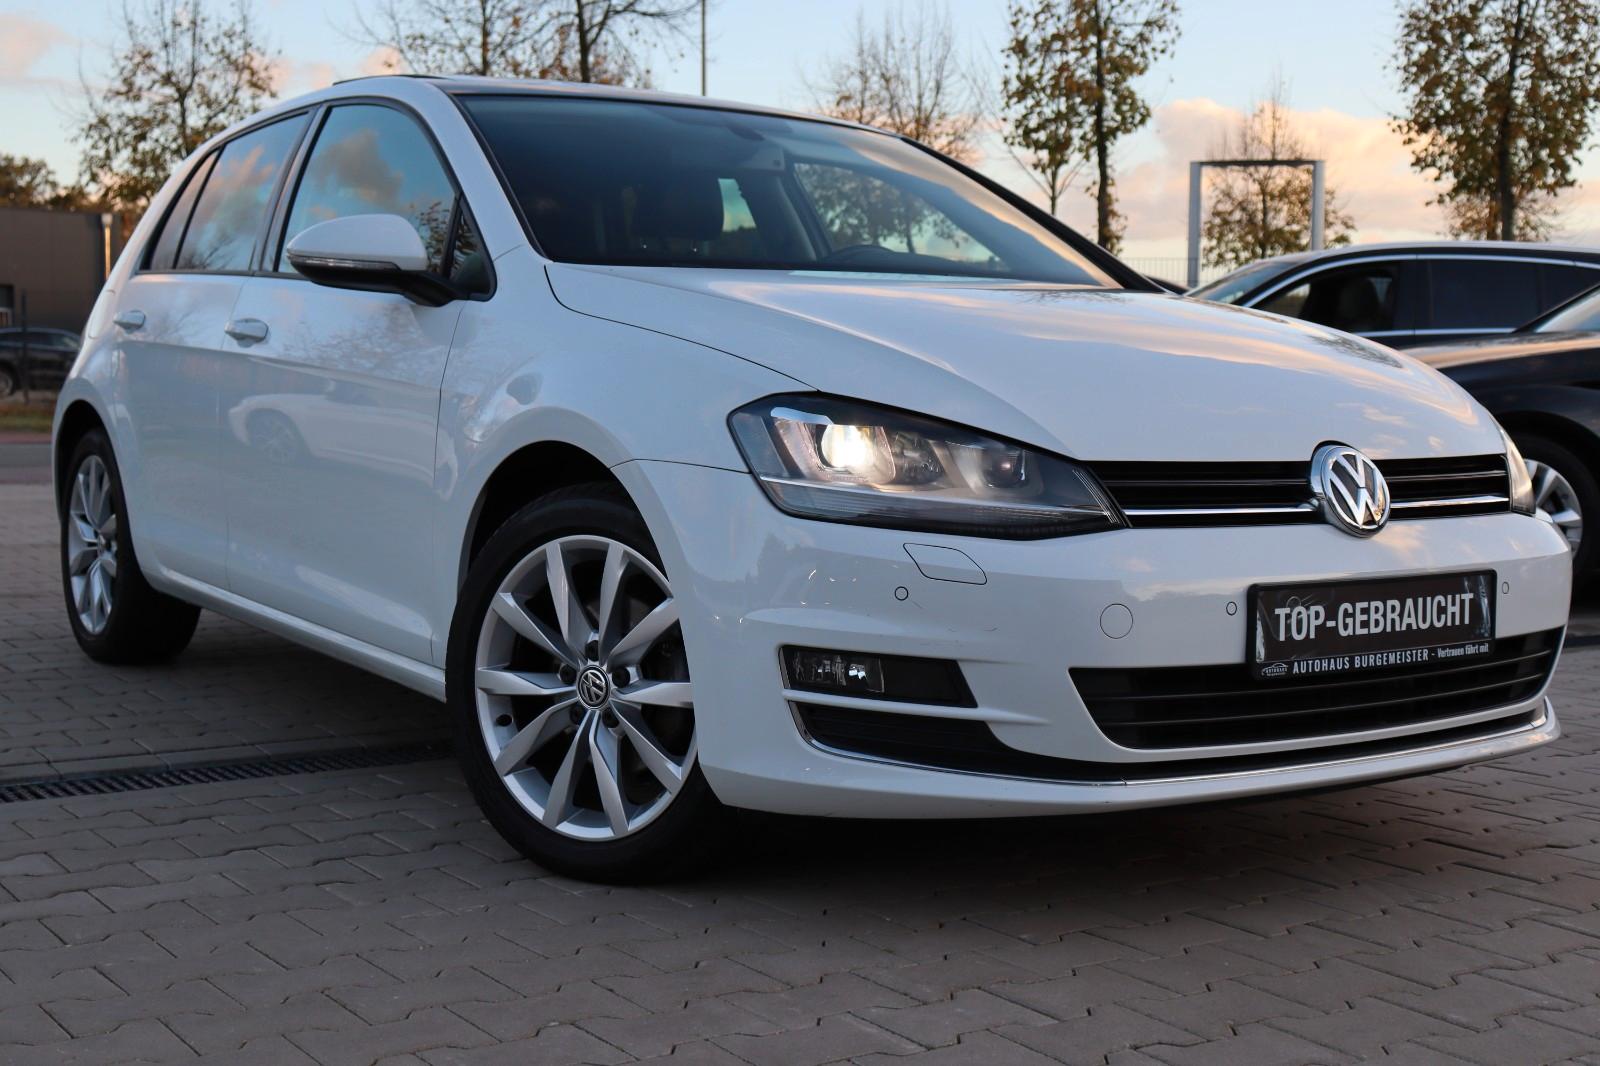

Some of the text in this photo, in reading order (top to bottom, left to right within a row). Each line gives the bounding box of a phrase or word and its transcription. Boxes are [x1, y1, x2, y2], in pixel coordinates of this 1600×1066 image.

[1324, 449, 1388, 530] VW
[1274, 592, 1473, 642] TOP-GEBRAUCHT
[1292, 656, 1350, 674] AUTOHAUS
[1354, 649, 1429, 668] BURGEMEISTER
[1437, 647, 1465, 658] Vertrauen
